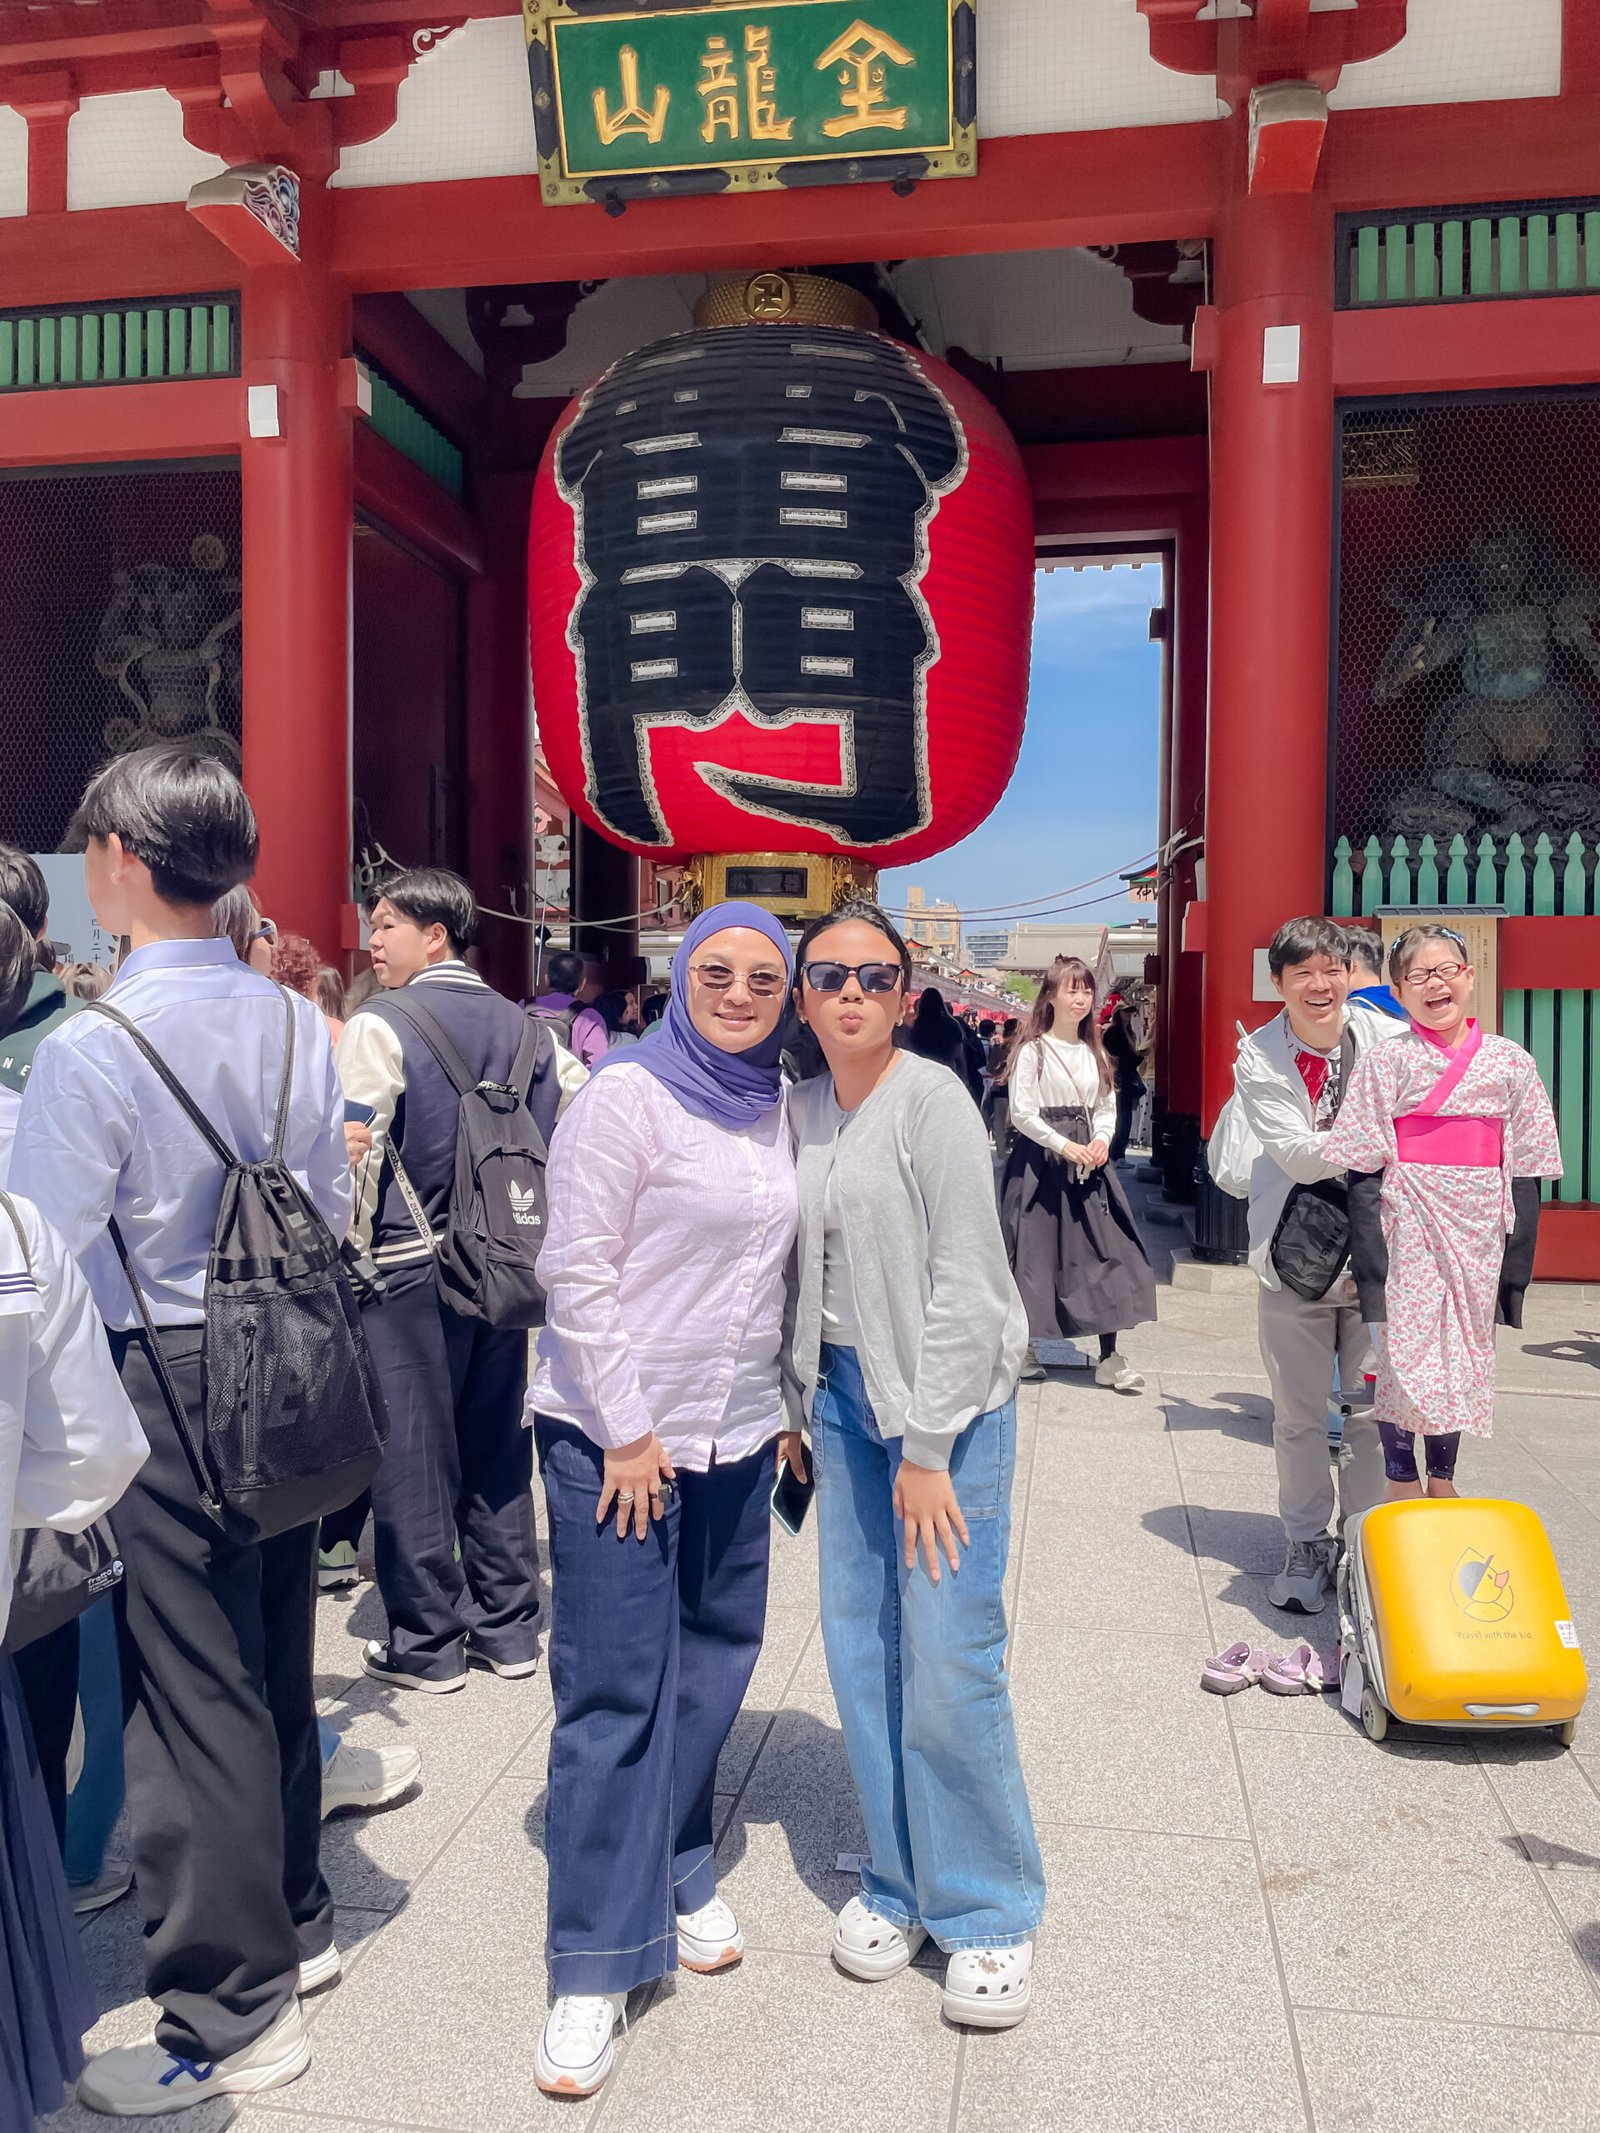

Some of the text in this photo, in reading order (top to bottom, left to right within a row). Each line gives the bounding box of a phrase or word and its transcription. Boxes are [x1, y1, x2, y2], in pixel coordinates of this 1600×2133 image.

[1456, 1630, 1532, 1639] Travel with the kid
